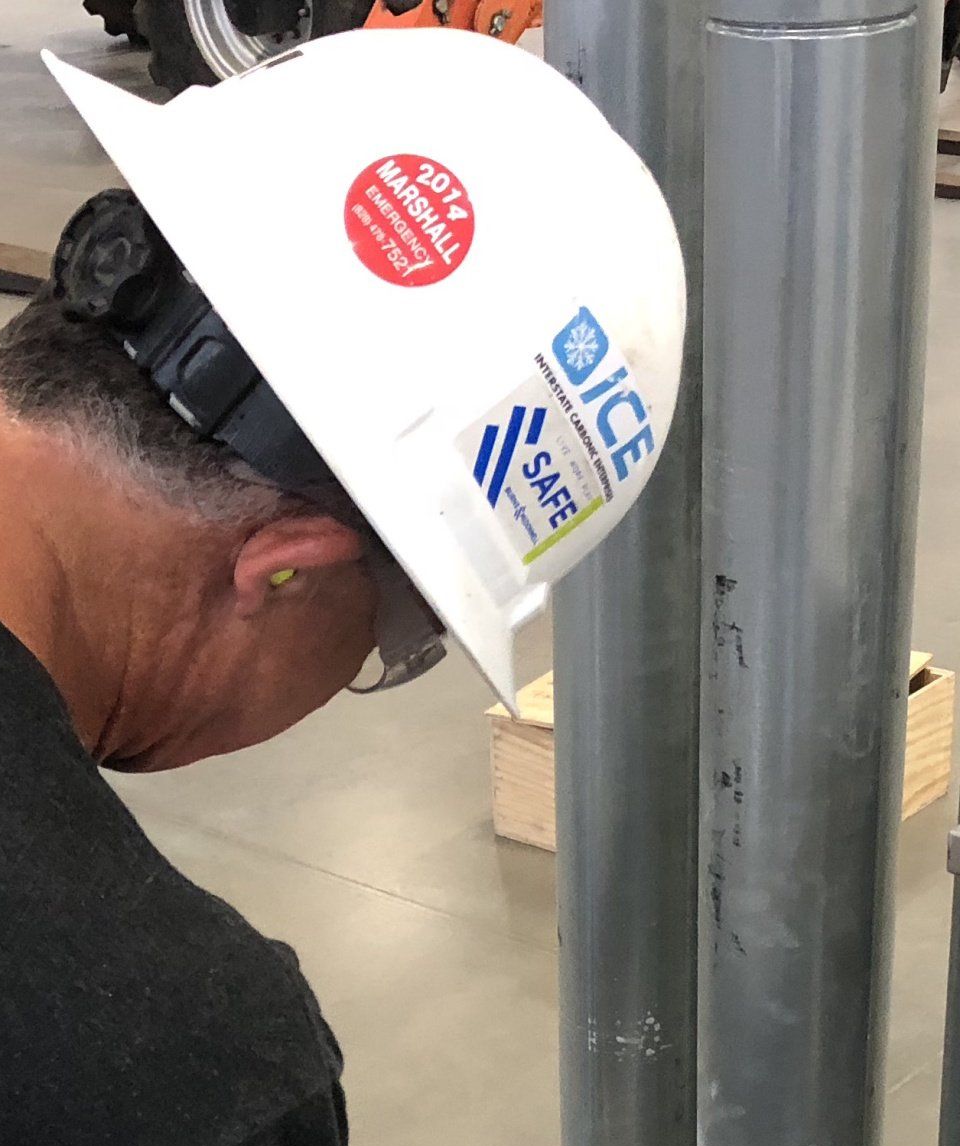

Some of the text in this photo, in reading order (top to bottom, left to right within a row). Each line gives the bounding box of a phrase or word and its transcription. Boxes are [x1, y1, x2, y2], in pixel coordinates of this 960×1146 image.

[364, 184, 434, 266] EMERGENCY
[375, 159, 461, 265] MARSHALL
[415, 163, 468, 221] 2014
[534, 352, 572, 414] INTERSTATE
[569, 412, 598, 463] CARBONIC
[579, 366, 655, 482] ICE
[522, 451, 579, 530] SAFE
